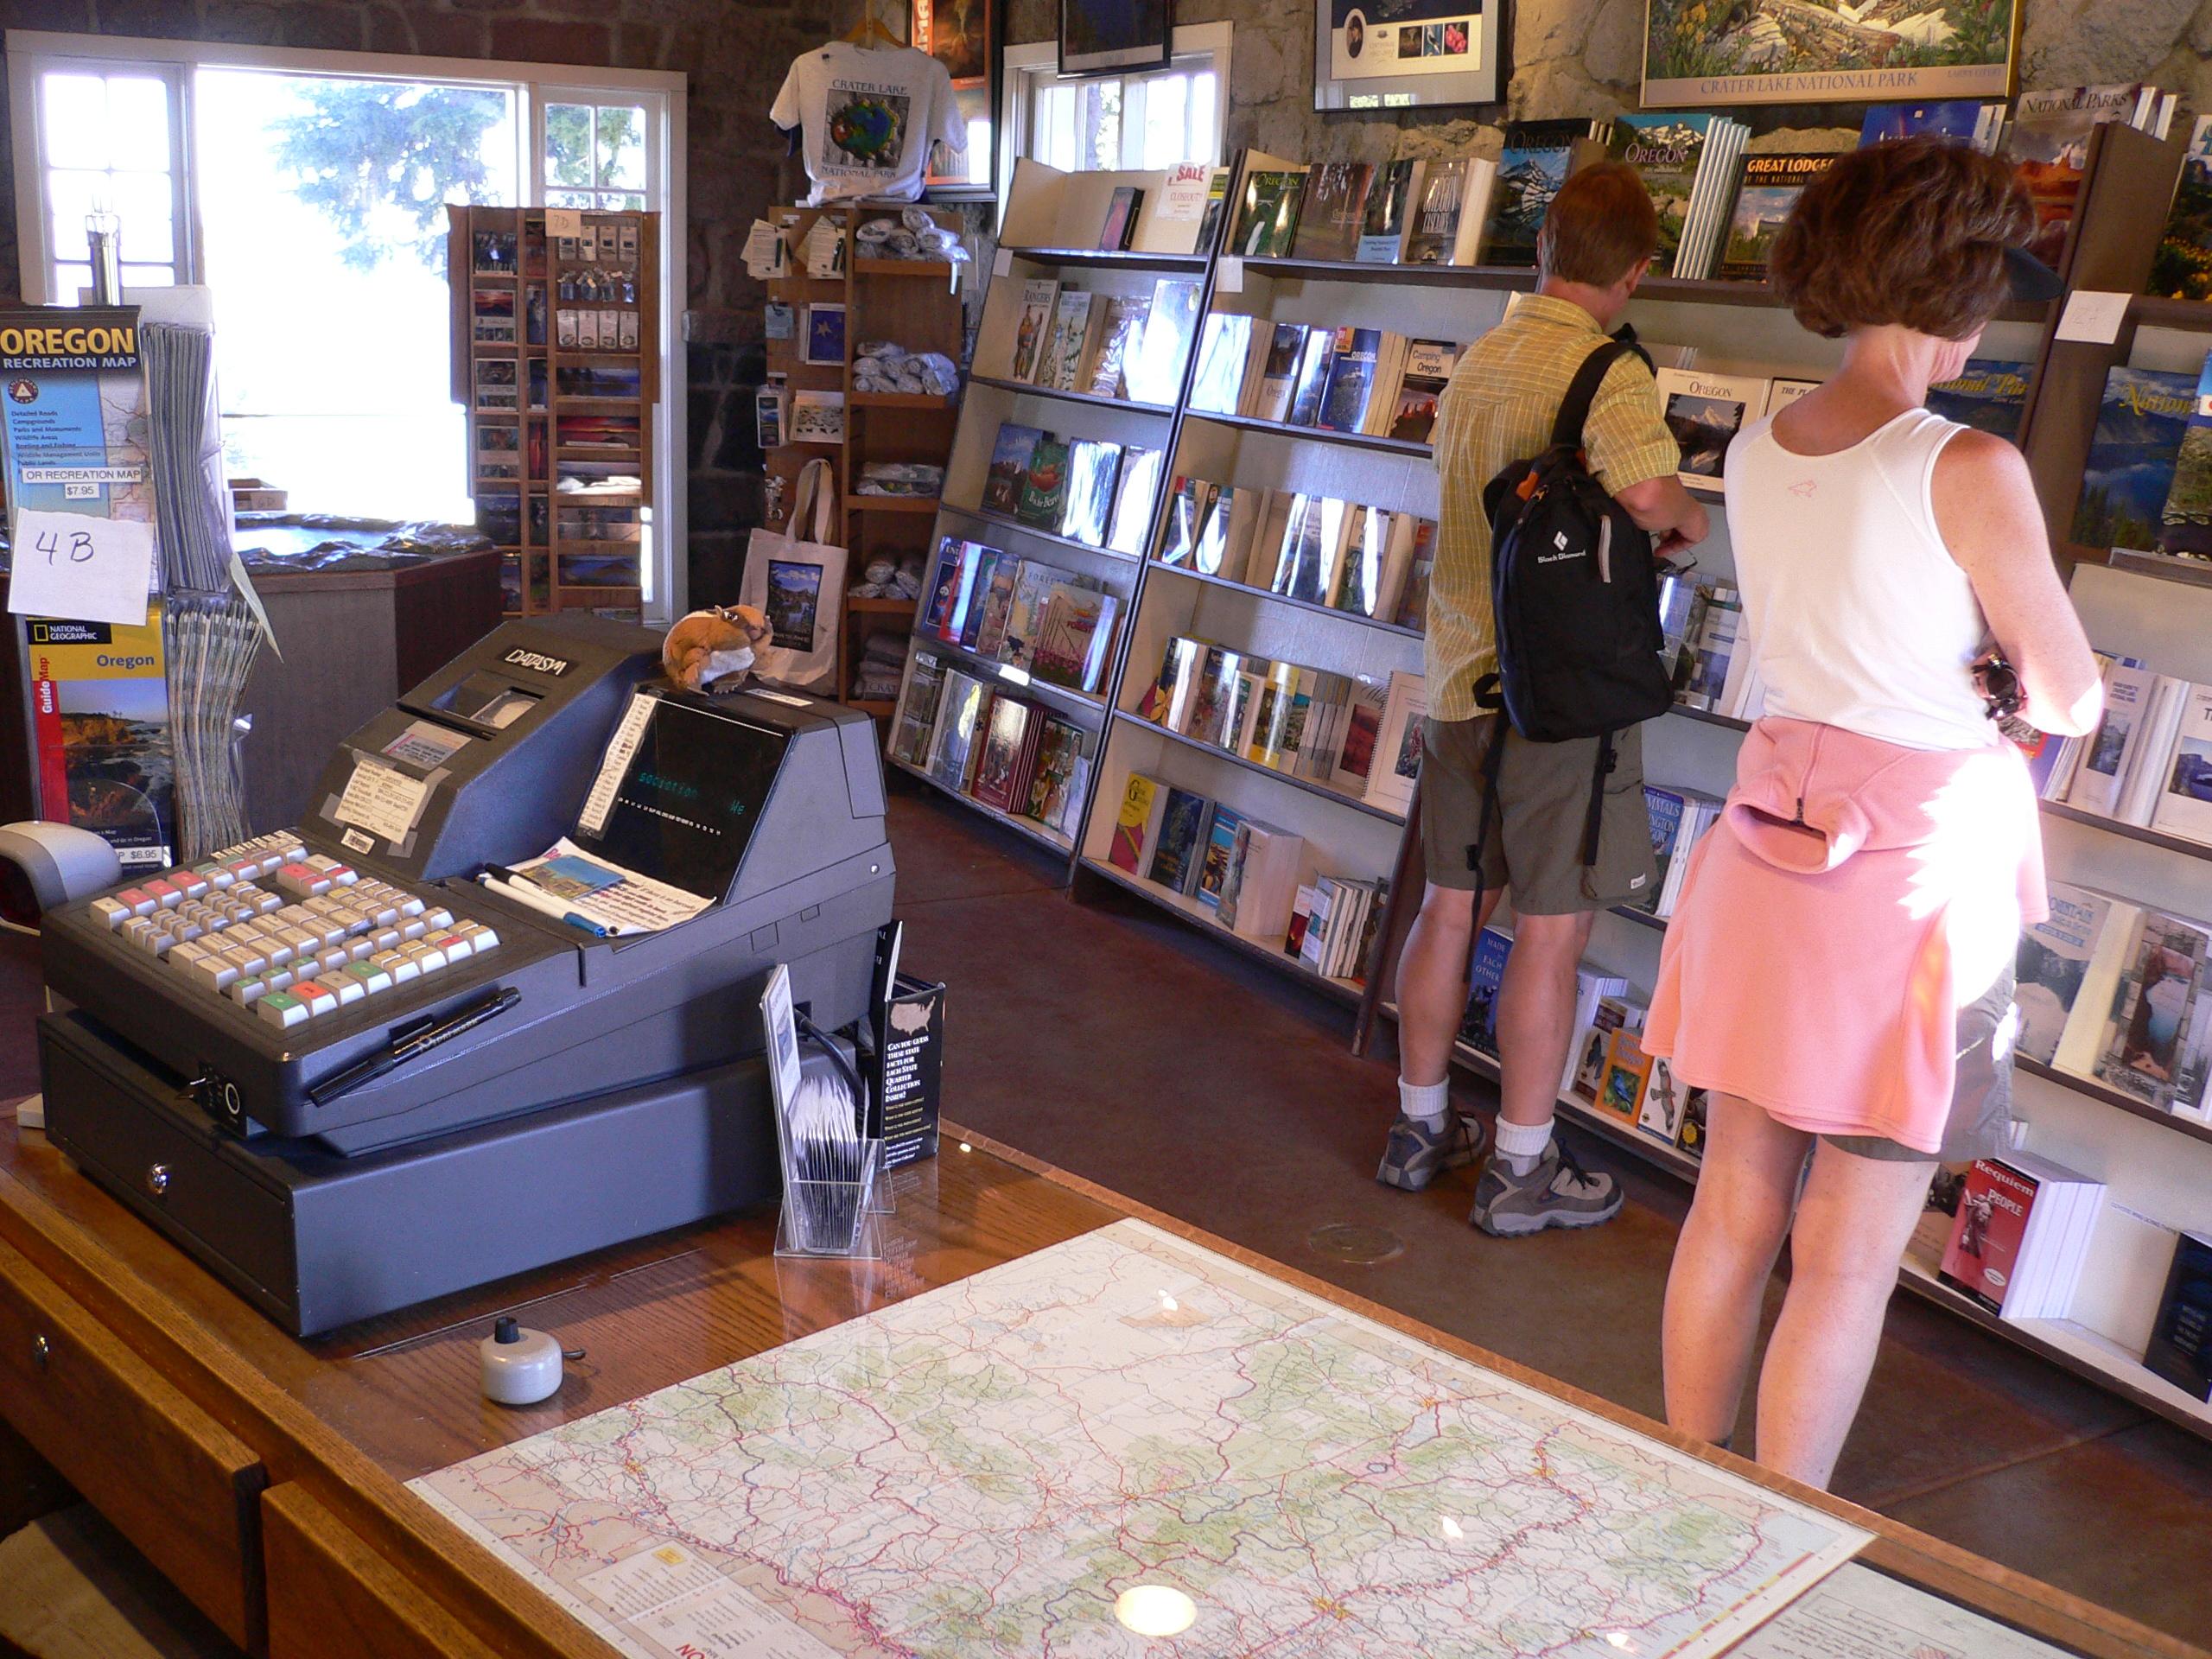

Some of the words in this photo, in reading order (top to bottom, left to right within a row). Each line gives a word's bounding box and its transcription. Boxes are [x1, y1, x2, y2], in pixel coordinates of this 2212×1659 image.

[832, 79, 874, 92] CRATER
[879, 85, 907, 95] LAKE
[1701, 78, 1754, 95] CRATER
[1758, 76, 1791, 92] LAKE
[1793, 73, 1873, 91] NATIONAL
[1878, 71, 1917, 87] PARK
[2023, 95, 2082, 114] NATIONAL
[2086, 92, 2130, 109] PARKS
[1510, 130, 1573, 155] OREGON
[1624, 142, 1686, 164] OREGON
[1176, 164, 1206, 182] SALE
[1747, 158, 1785, 173] GREAT
[0, 327, 136, 356] OREGON
[3, 356, 97, 369] RECREATION
[102, 356, 137, 368] MAP
[1413, 349, 1441, 362] Camping
[1417, 361, 1442, 375] Oregon
[1689, 381, 1732, 397] OREGON
[1782, 386, 1796, 396] THE
[26, 471, 42, 480] OR
[46, 470, 114, 480] RECREATION
[117, 470, 141, 480] MAP
[67, 486, 94, 496] $7.95
[1537, 554, 1558, 563] Black
[1558, 549, 1586, 562] Diamond
[49, 625, 87, 633] NATIONAL
[49, 631, 98, 641] GEOGRAPHIC
[96, 653, 155, 669] Oregon
[130, 849, 156, 860] $6.95
[1487, 938, 1506, 952] MADE
[1483, 954, 1503, 969] EACH
[1475, 964, 1501, 982] OTHER
[1974, 1159, 2035, 1198] Requiem
[1987, 1187, 2024, 1217] PEOPLE
